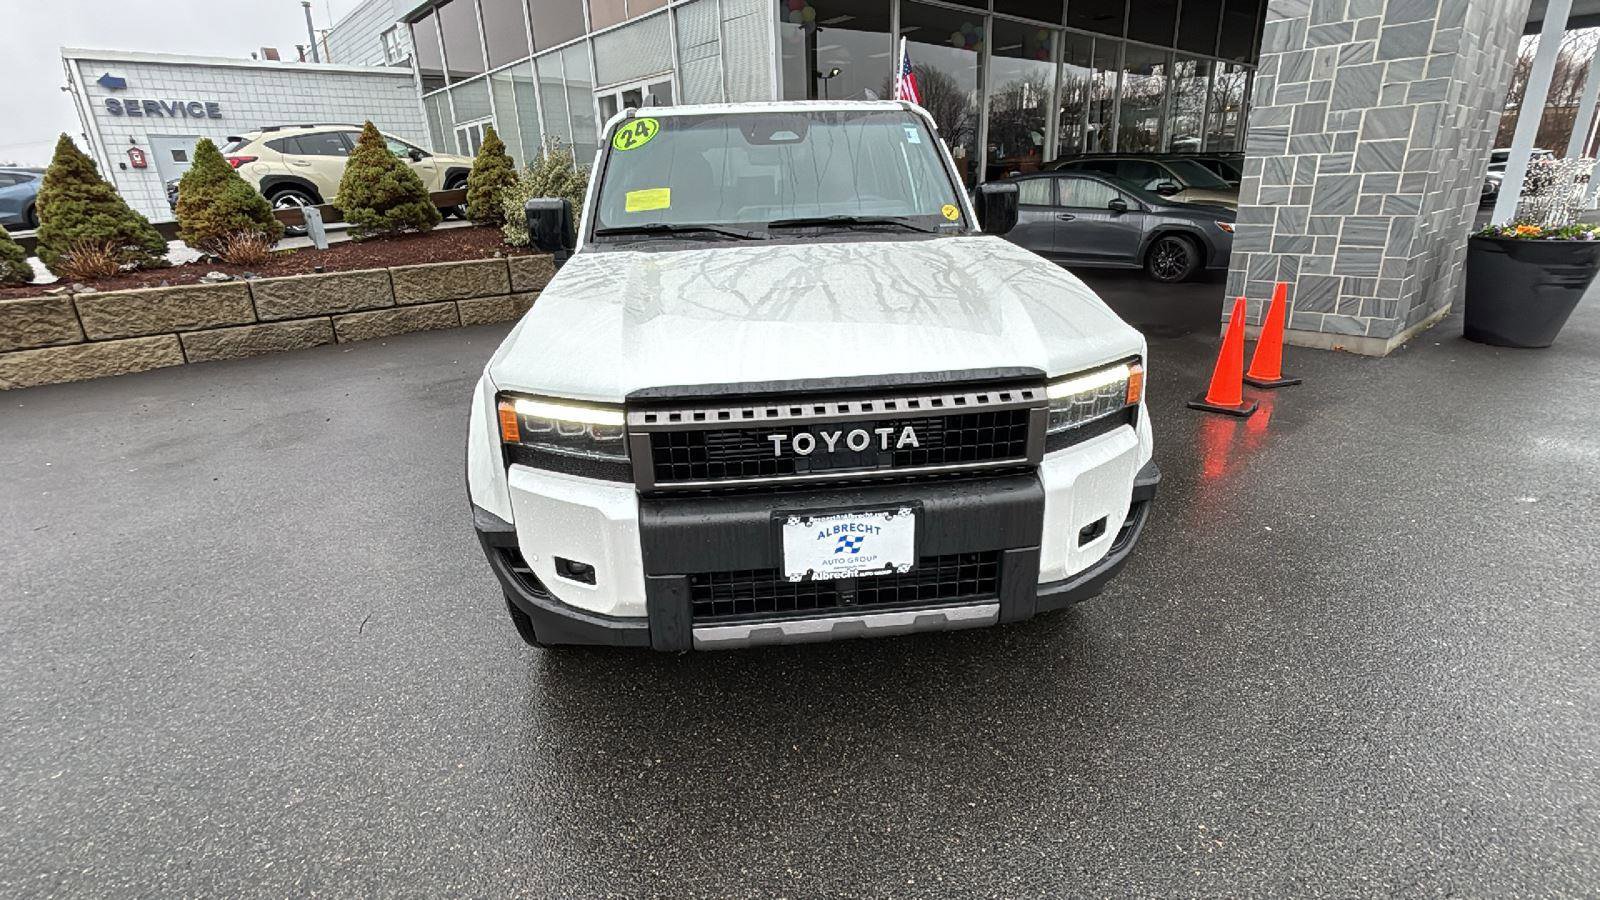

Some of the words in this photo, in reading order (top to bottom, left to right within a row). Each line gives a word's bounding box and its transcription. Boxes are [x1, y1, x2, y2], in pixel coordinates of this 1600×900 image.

[105, 98, 222, 119] SERVICE
[621, 121, 650, 148] 24
[767, 426, 920, 457] TOYOTA
[817, 523, 881, 540] ALBRECHT
[822, 558, 846, 566] AUTO
[847, 555, 878, 564] GROUP
[811, 568, 859, 581] Albrecht
